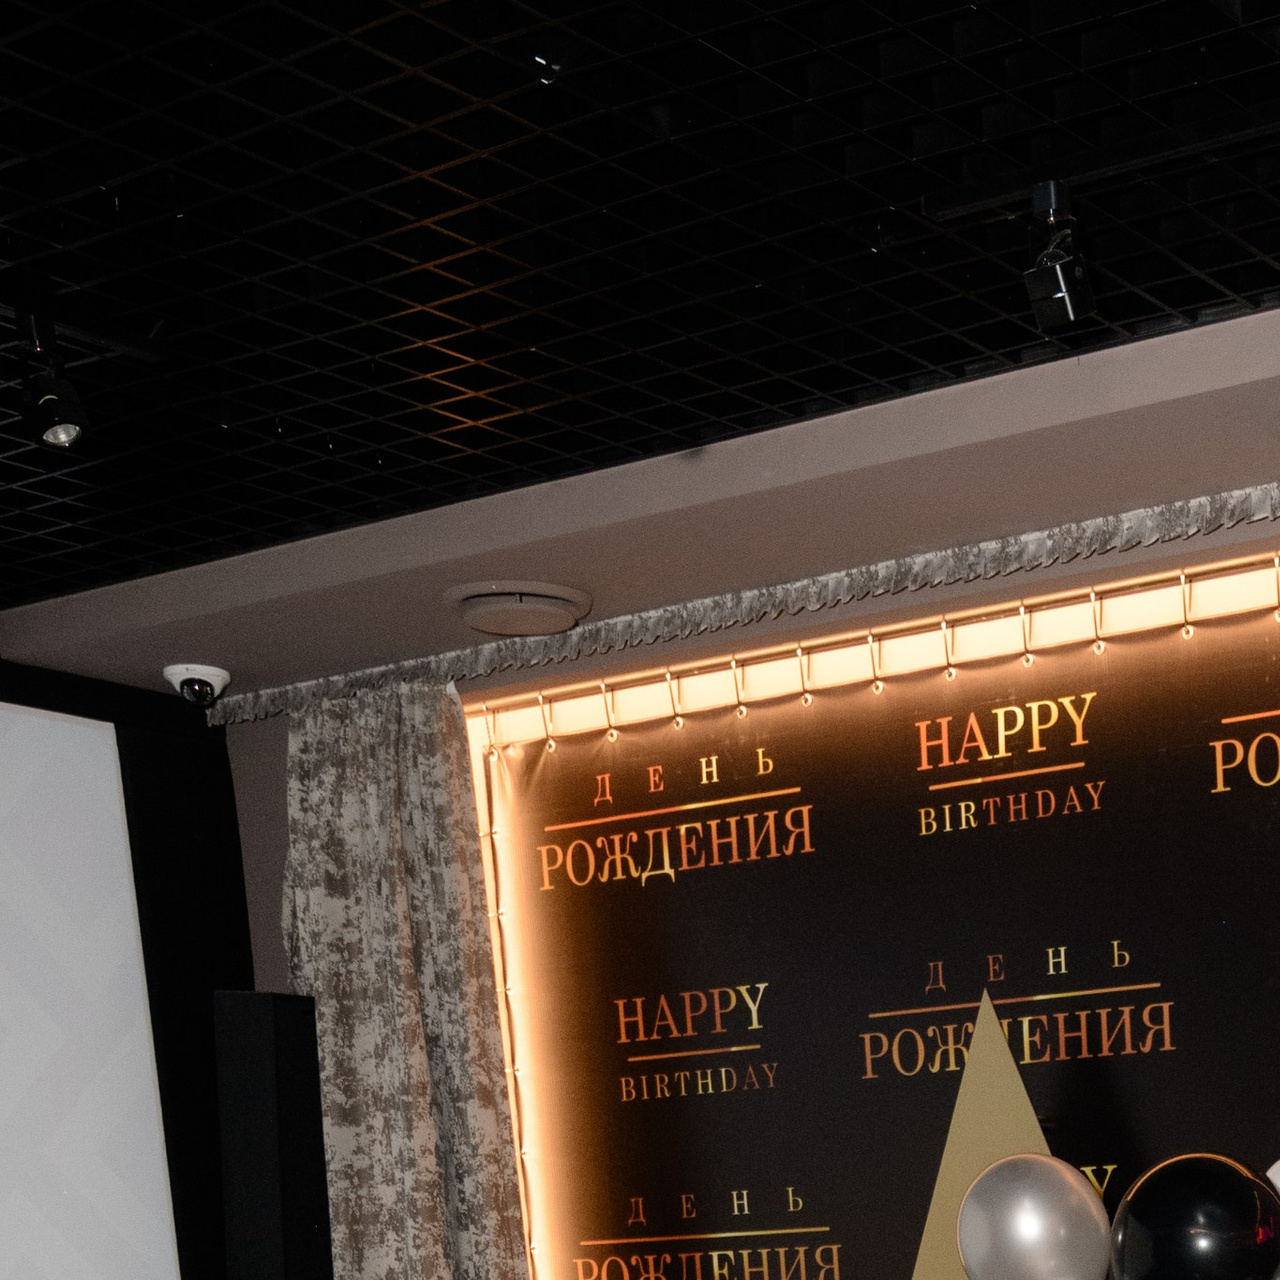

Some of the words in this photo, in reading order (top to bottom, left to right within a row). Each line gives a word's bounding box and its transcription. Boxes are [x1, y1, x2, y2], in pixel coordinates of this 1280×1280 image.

[915, 692, 1097, 771] HAPPY
[593, 748, 774, 806] ДЕНЬ
[918, 780, 1106, 836] BIRTHDAY
[537, 805, 816, 891] РОЖДЕНИЯ
[925, 940, 1130, 995] ДЕНЬ
[614, 982, 769, 1043] HAPPY
[859, 1002, 1177, 1079] РОЖЕНИЯ
[619, 1062, 779, 1102] BIRTHDAY
[628, 1187, 804, 1224] ДЕНЬ
